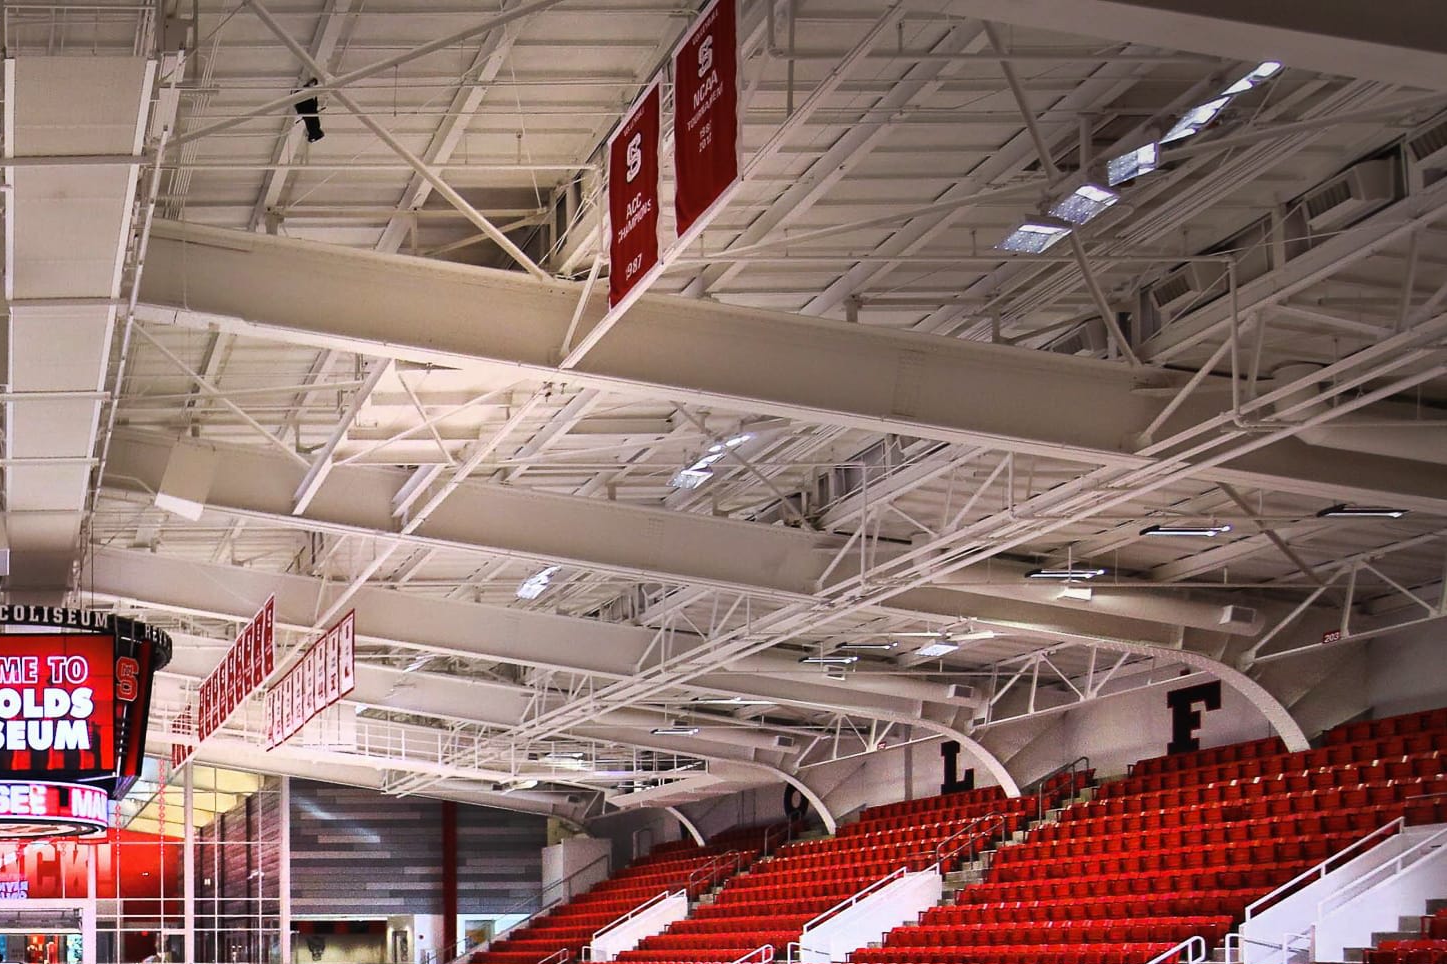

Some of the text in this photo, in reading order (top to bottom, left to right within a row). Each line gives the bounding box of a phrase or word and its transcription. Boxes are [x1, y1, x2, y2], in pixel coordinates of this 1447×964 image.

[693, 69, 718, 109] NCAA
[626, 192, 642, 218] ACC
[47, 655, 89, 684] TO
